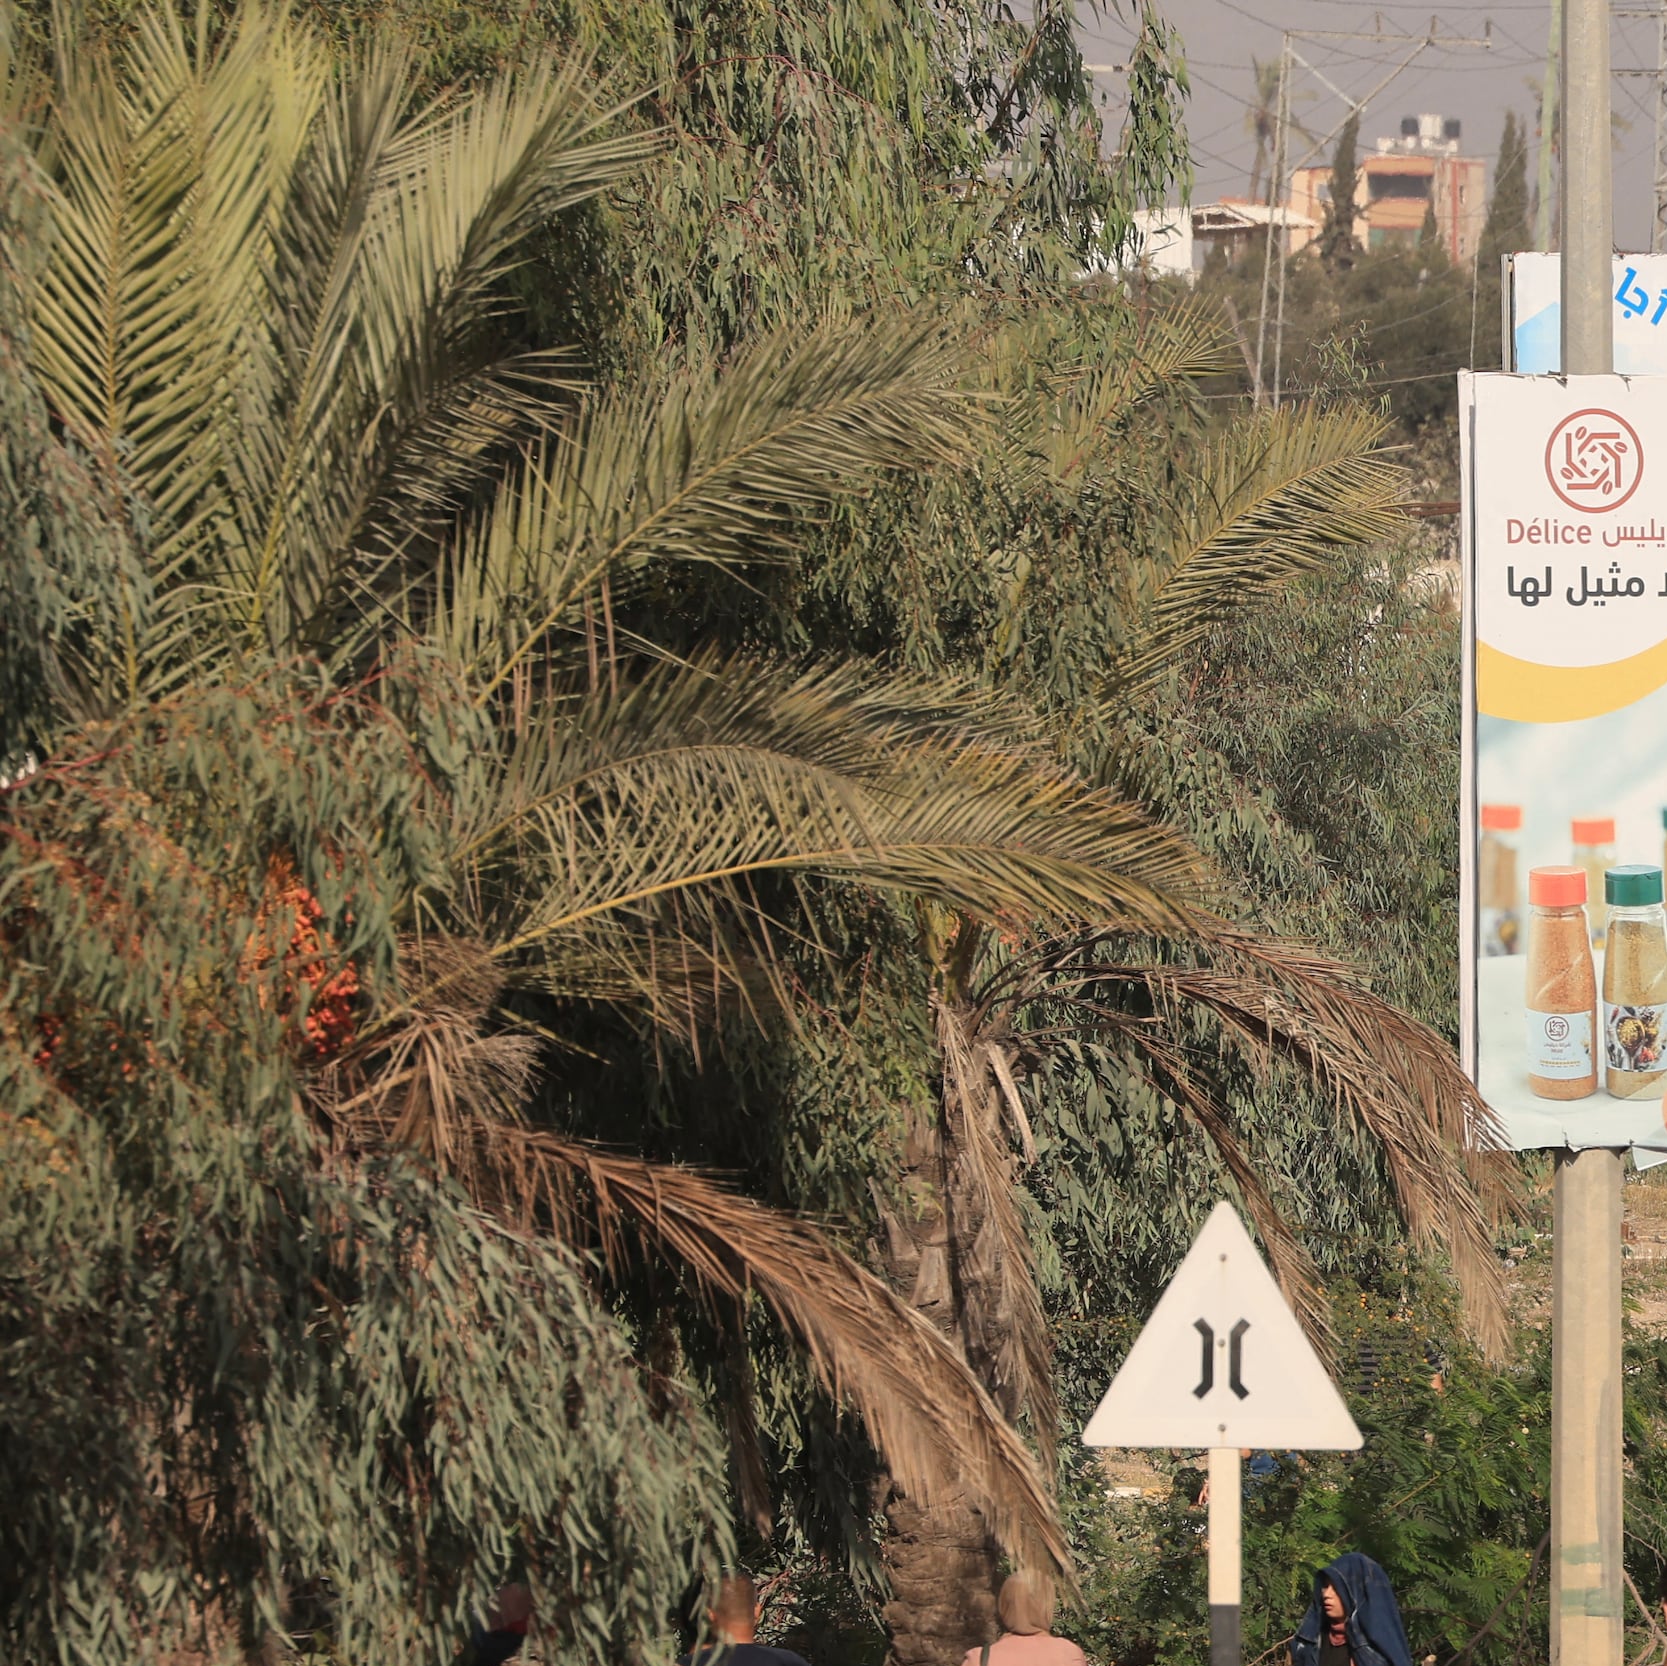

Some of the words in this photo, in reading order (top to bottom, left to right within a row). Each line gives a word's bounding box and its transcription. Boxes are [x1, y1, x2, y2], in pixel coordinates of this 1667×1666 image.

[1506, 517, 1592, 544] Délice
[1507, 565, 1552, 607] لها
[1565, 561, 1645, 606] مثيل
